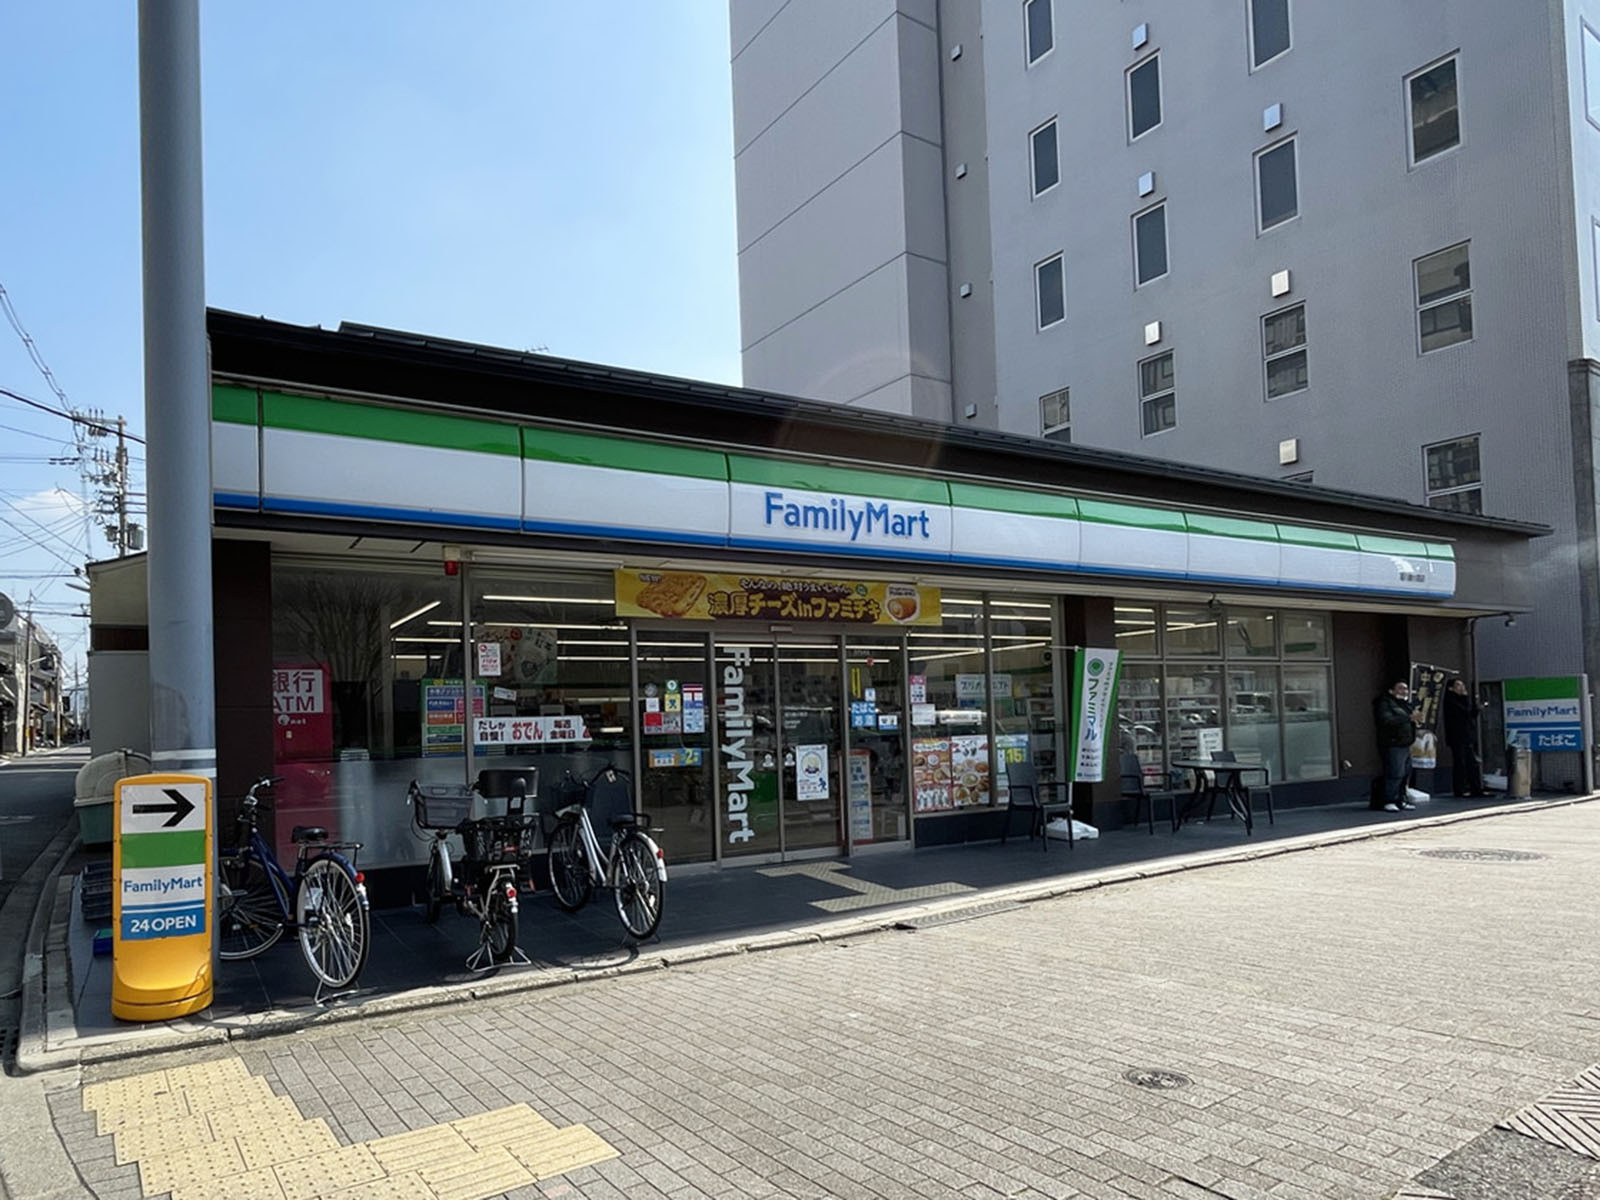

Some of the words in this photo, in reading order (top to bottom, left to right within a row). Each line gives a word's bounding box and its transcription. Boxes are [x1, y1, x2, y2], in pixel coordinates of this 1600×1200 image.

[765, 492, 929, 541] FamilyMart
[708, 590, 881, 619] 濃厚チーズinファミチキ
[1085, 678, 1099, 741] ファミマル
[1507, 705, 1577, 718] FamilyMart
[512, 722, 543, 740] おでん
[554, 720, 571, 728] 毎週
[550, 730, 576, 739] 金曜日
[1538, 734, 1577, 746] たばこ
[722, 647, 754, 843] FamilyMart
[123, 876, 203, 893] FamilyMart
[131, 919, 150, 932] 24
[151, 915, 197, 931] OPEN
